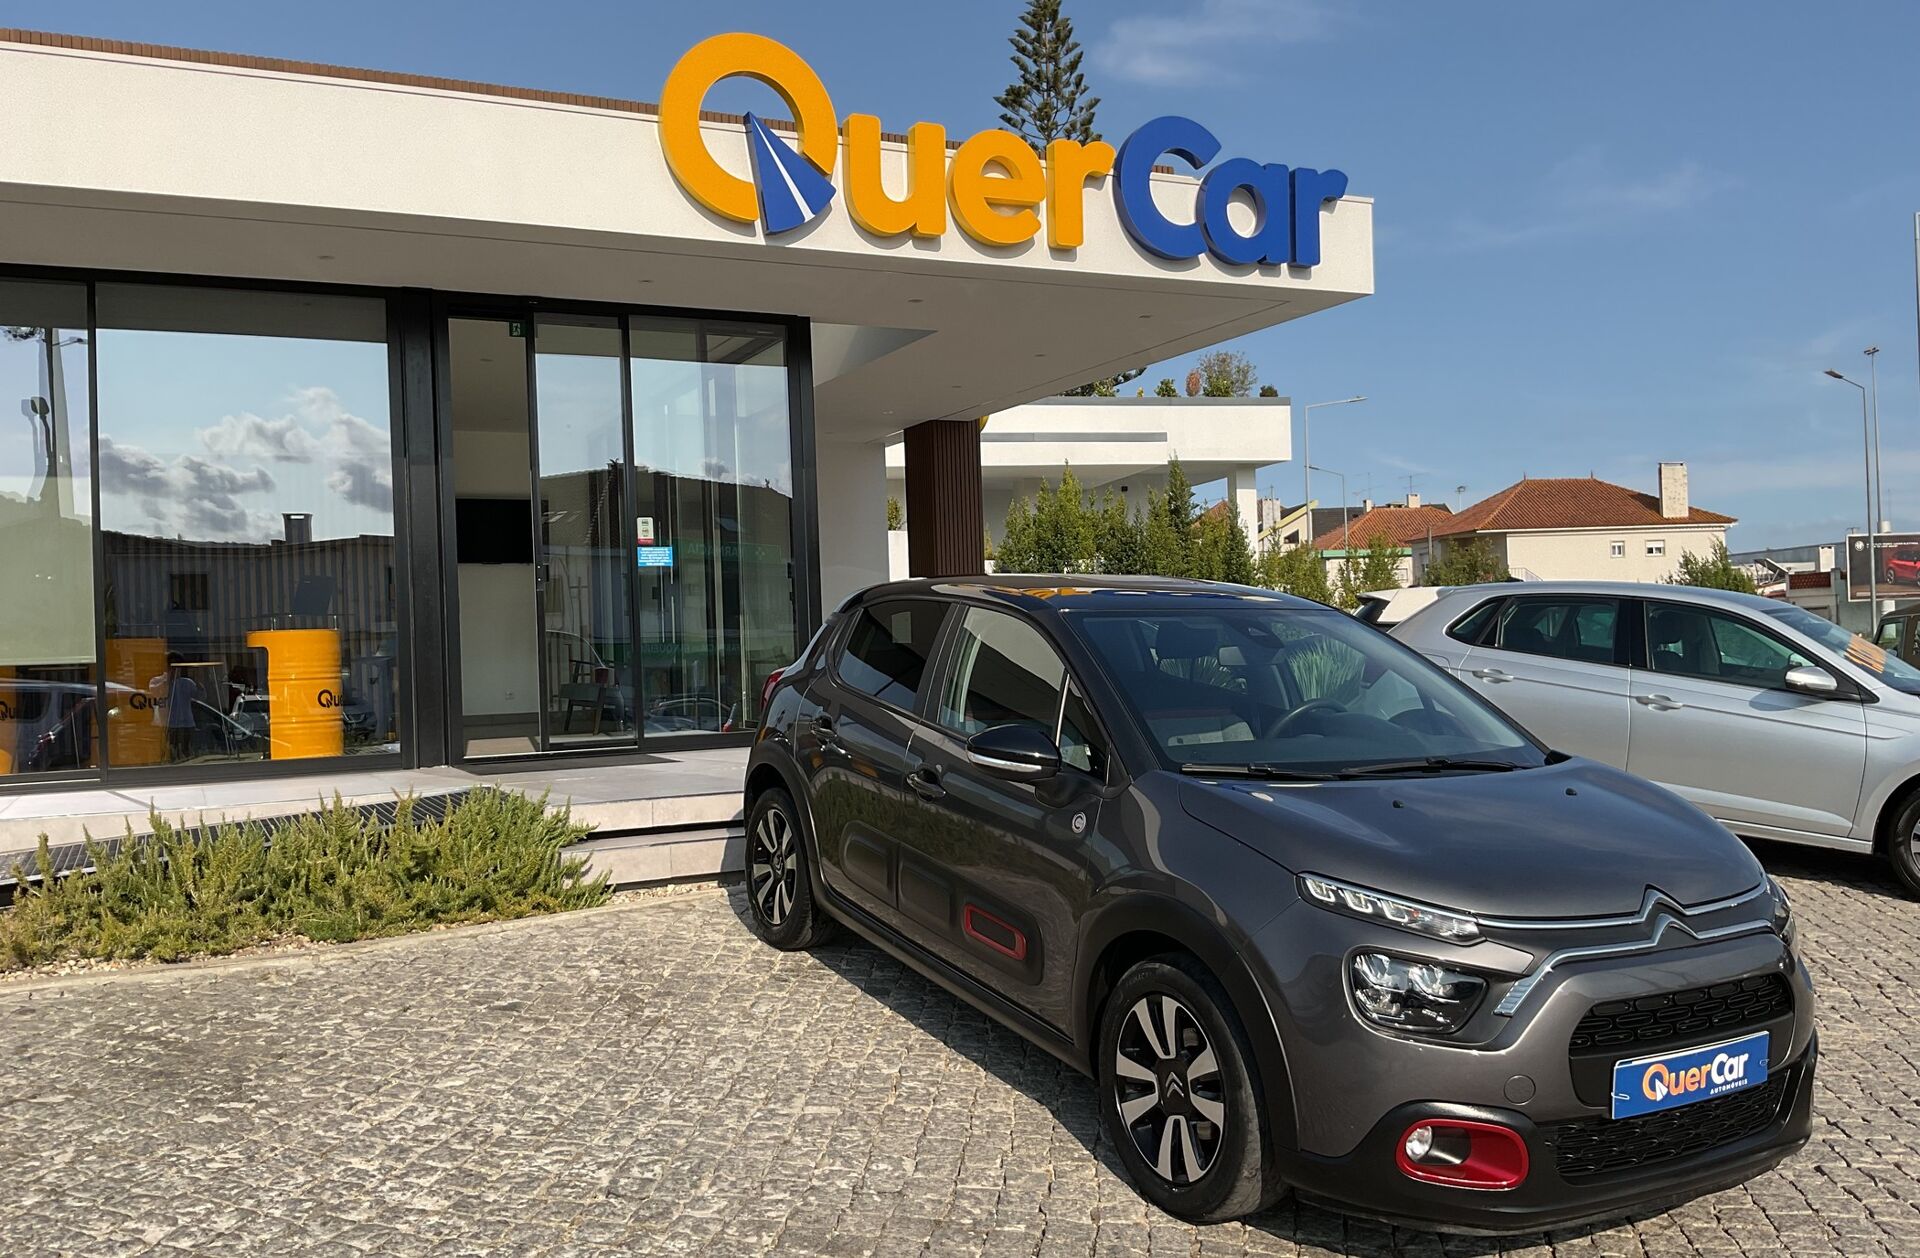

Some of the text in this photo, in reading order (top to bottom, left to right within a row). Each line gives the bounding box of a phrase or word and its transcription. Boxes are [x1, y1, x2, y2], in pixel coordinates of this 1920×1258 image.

[659, 32, 1348, 268] QuerCar
[1643, 1053, 1749, 1101] QuerCar
[1710, 1079, 1748, 1095] AUTOMÓVEIS
